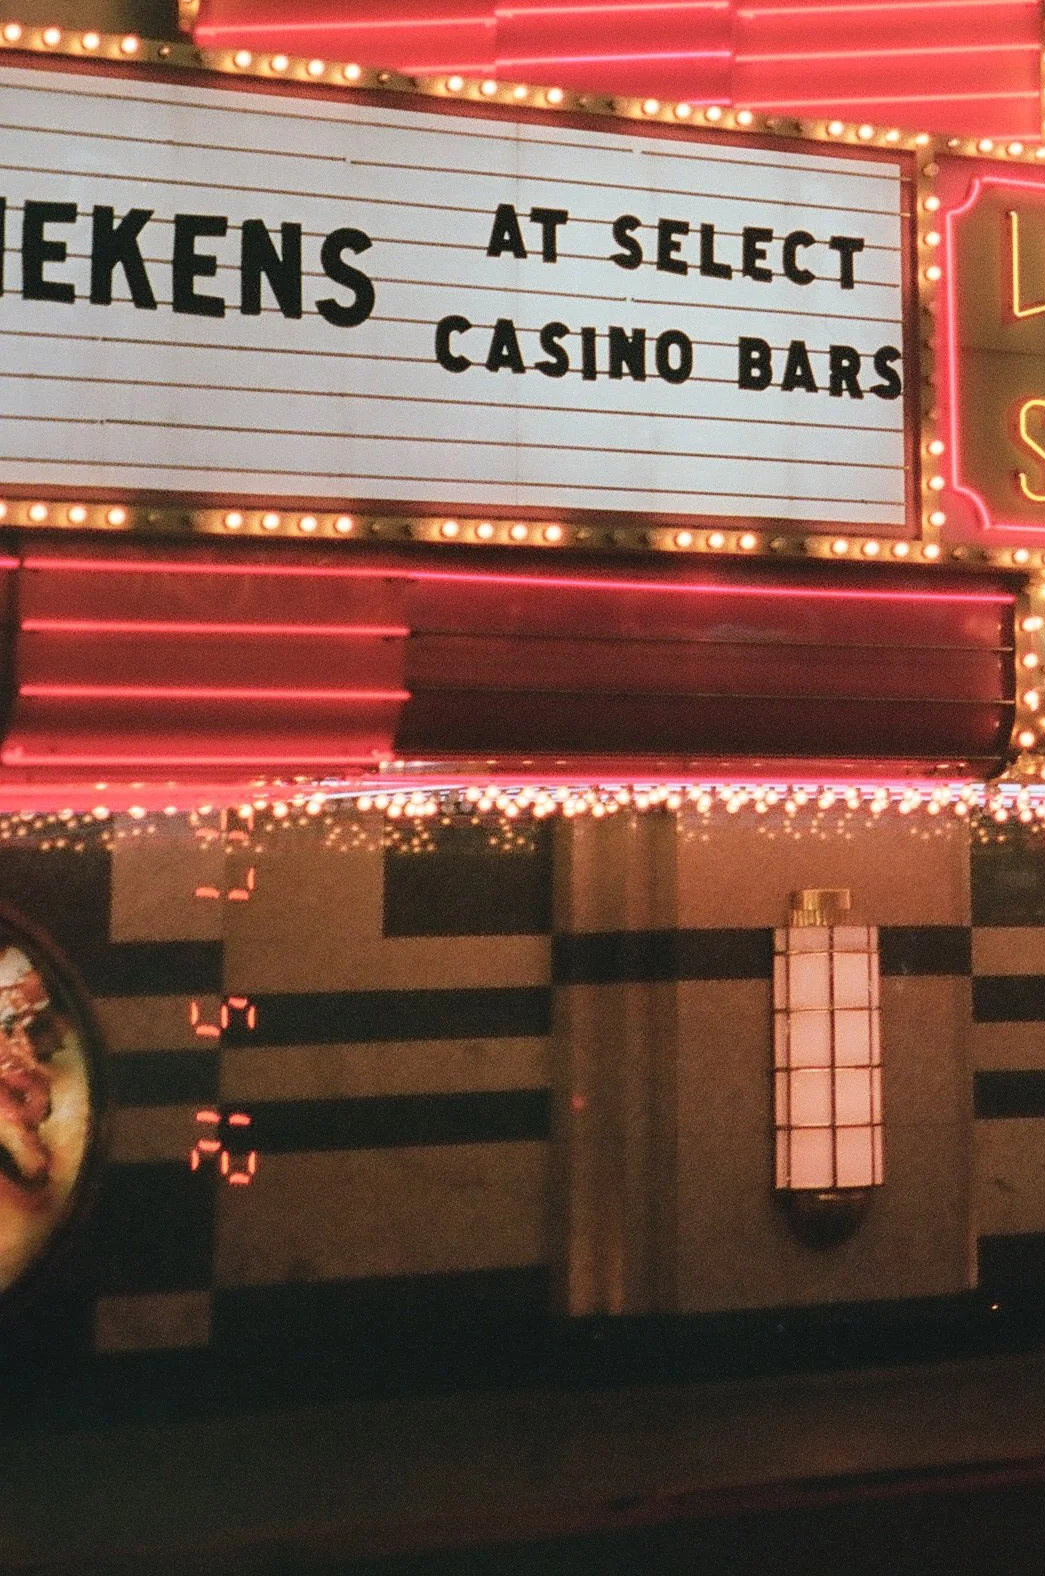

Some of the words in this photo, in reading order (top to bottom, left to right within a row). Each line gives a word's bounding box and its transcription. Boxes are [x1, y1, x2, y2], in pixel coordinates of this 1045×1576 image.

[0, 197, 377, 327] EKENS
[487, 203, 570, 263] AT
[611, 214, 865, 290] SELECT
[435, 314, 694, 385] CASINO
[737, 335, 904, 401] BARS
